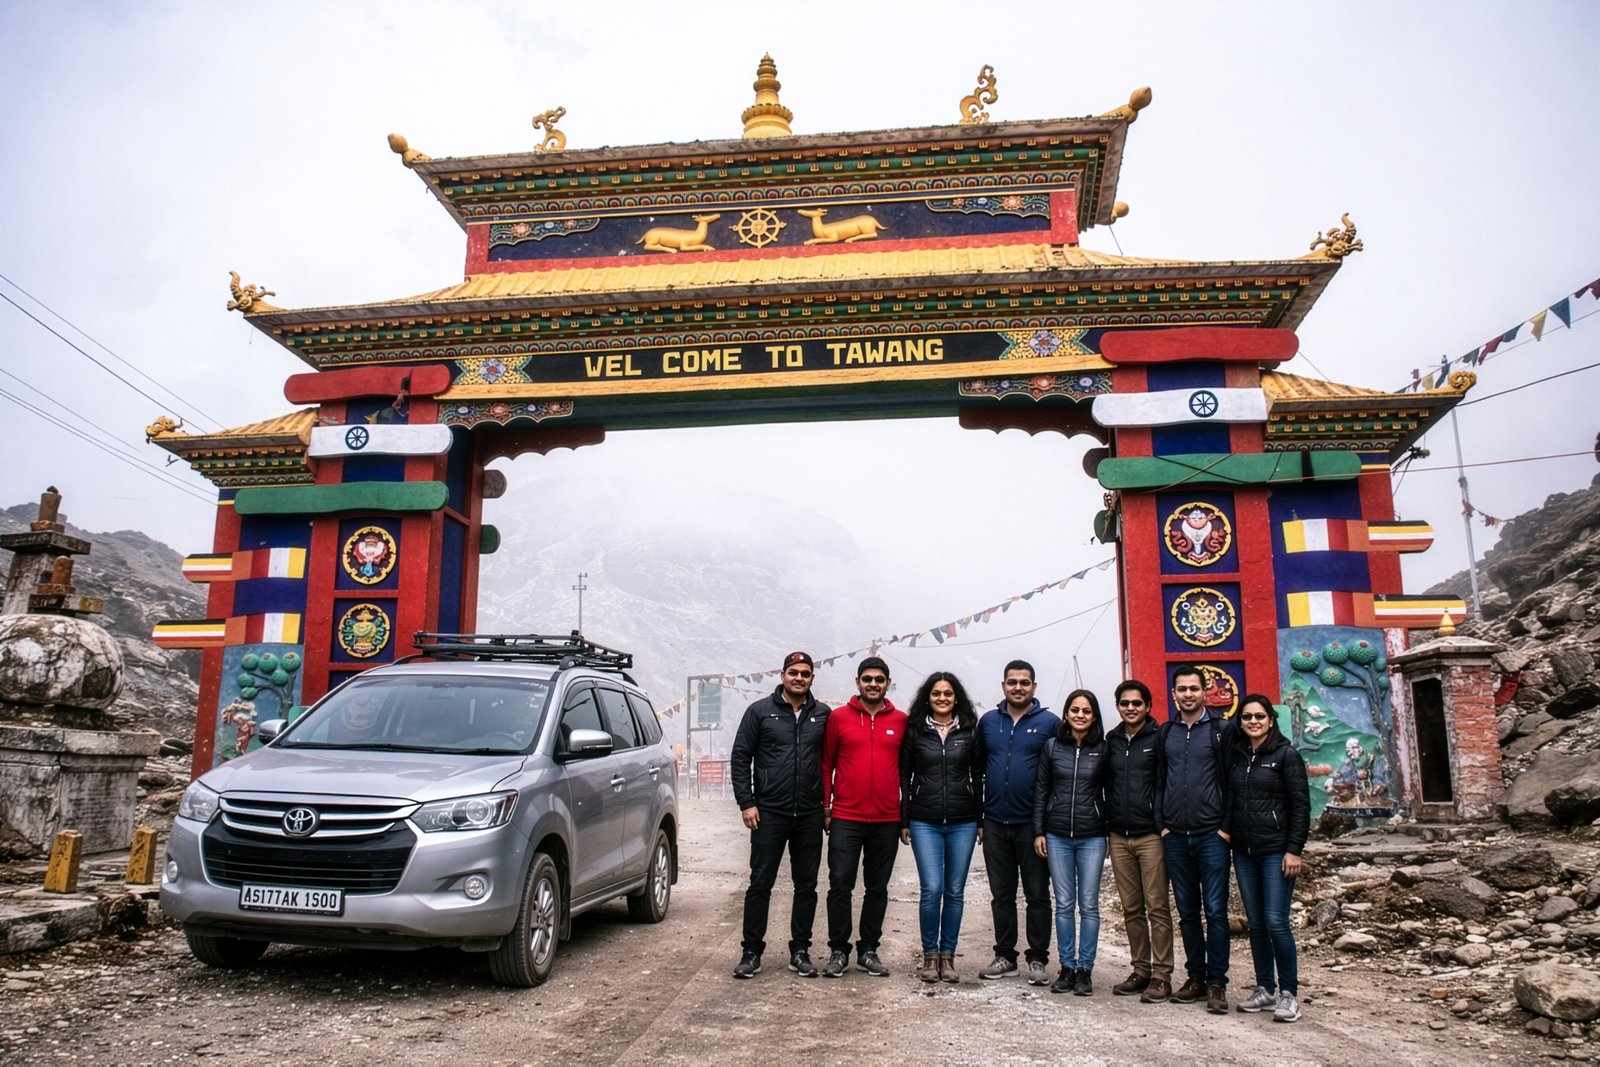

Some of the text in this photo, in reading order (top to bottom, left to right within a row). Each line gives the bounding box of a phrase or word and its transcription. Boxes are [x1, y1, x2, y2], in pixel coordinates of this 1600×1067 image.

[584, 338, 944, 378] WEL COME TO TAWANG
